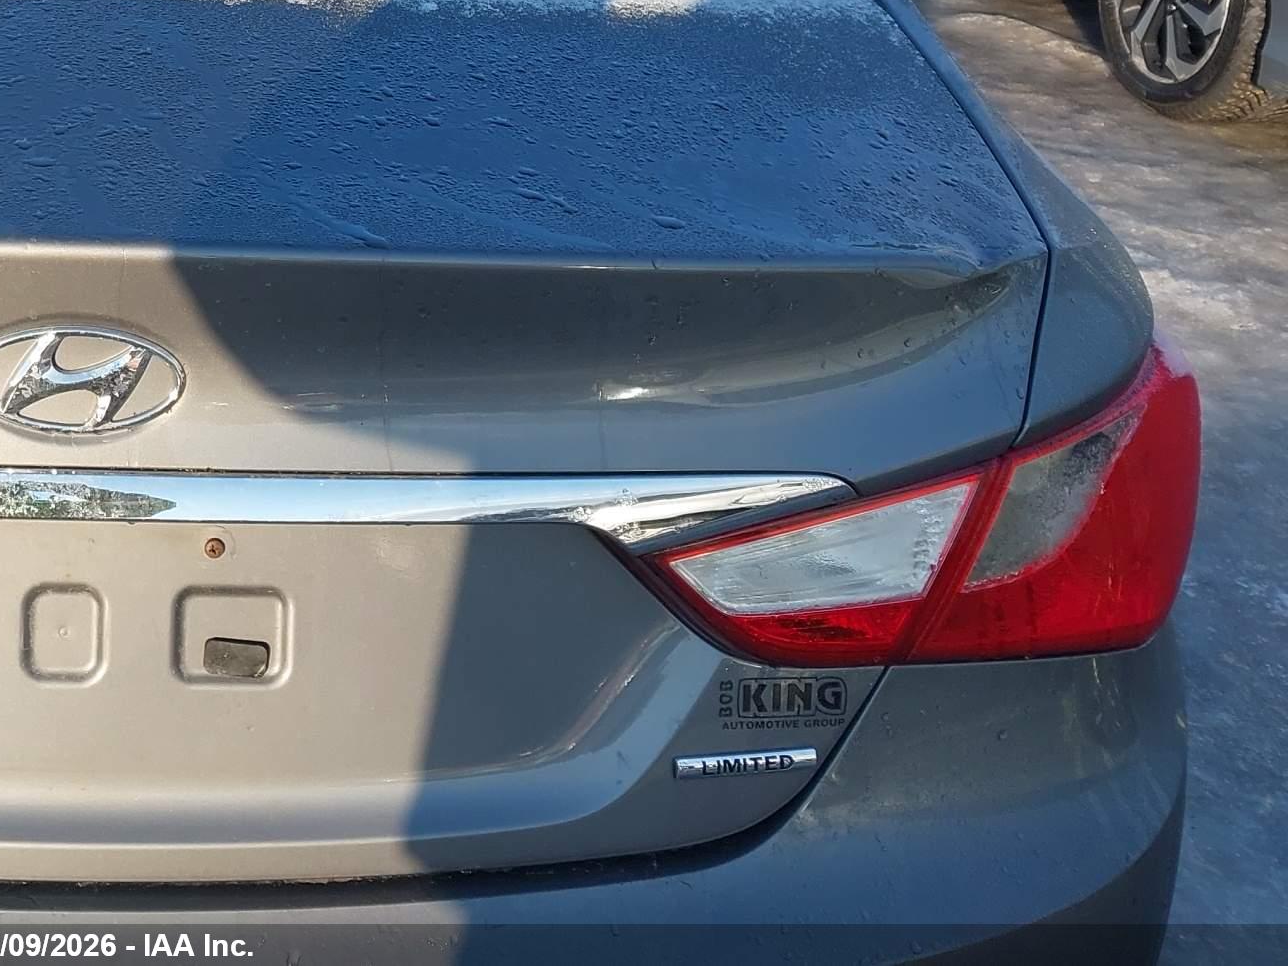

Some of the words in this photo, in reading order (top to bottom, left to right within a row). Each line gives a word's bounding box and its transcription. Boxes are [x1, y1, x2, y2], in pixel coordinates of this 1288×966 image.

[718, 680, 734, 718] BOB
[739, 679, 846, 716] KING
[722, 720, 800, 730] AUTOMOTIVE
[804, 718, 846, 728] GROUP
[702, 755, 796, 776] LIMITED
